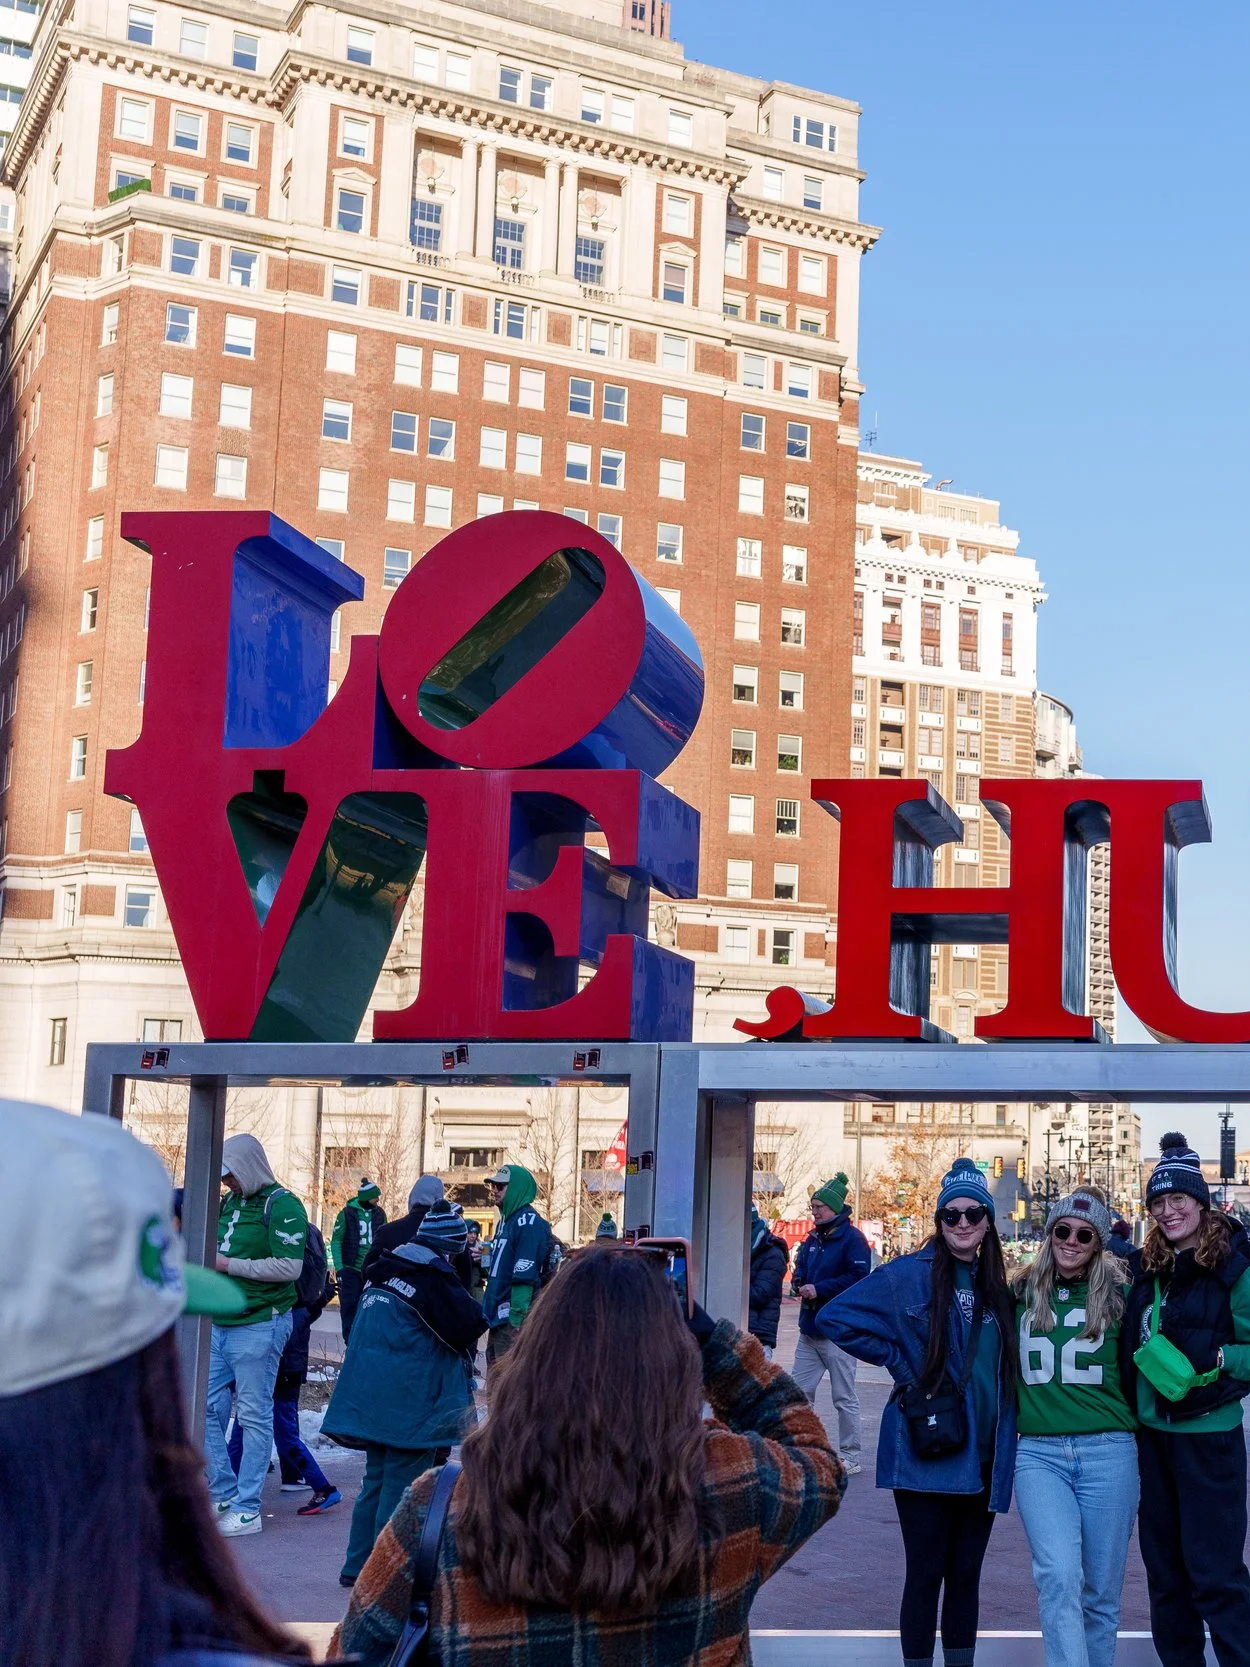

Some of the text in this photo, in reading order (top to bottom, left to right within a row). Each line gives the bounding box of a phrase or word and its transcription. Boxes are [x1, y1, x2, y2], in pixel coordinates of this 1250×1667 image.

[1151, 1181, 1173, 1192] THING
[220, 1209, 241, 1252] 1
[1019, 1307, 1106, 1386] 62
